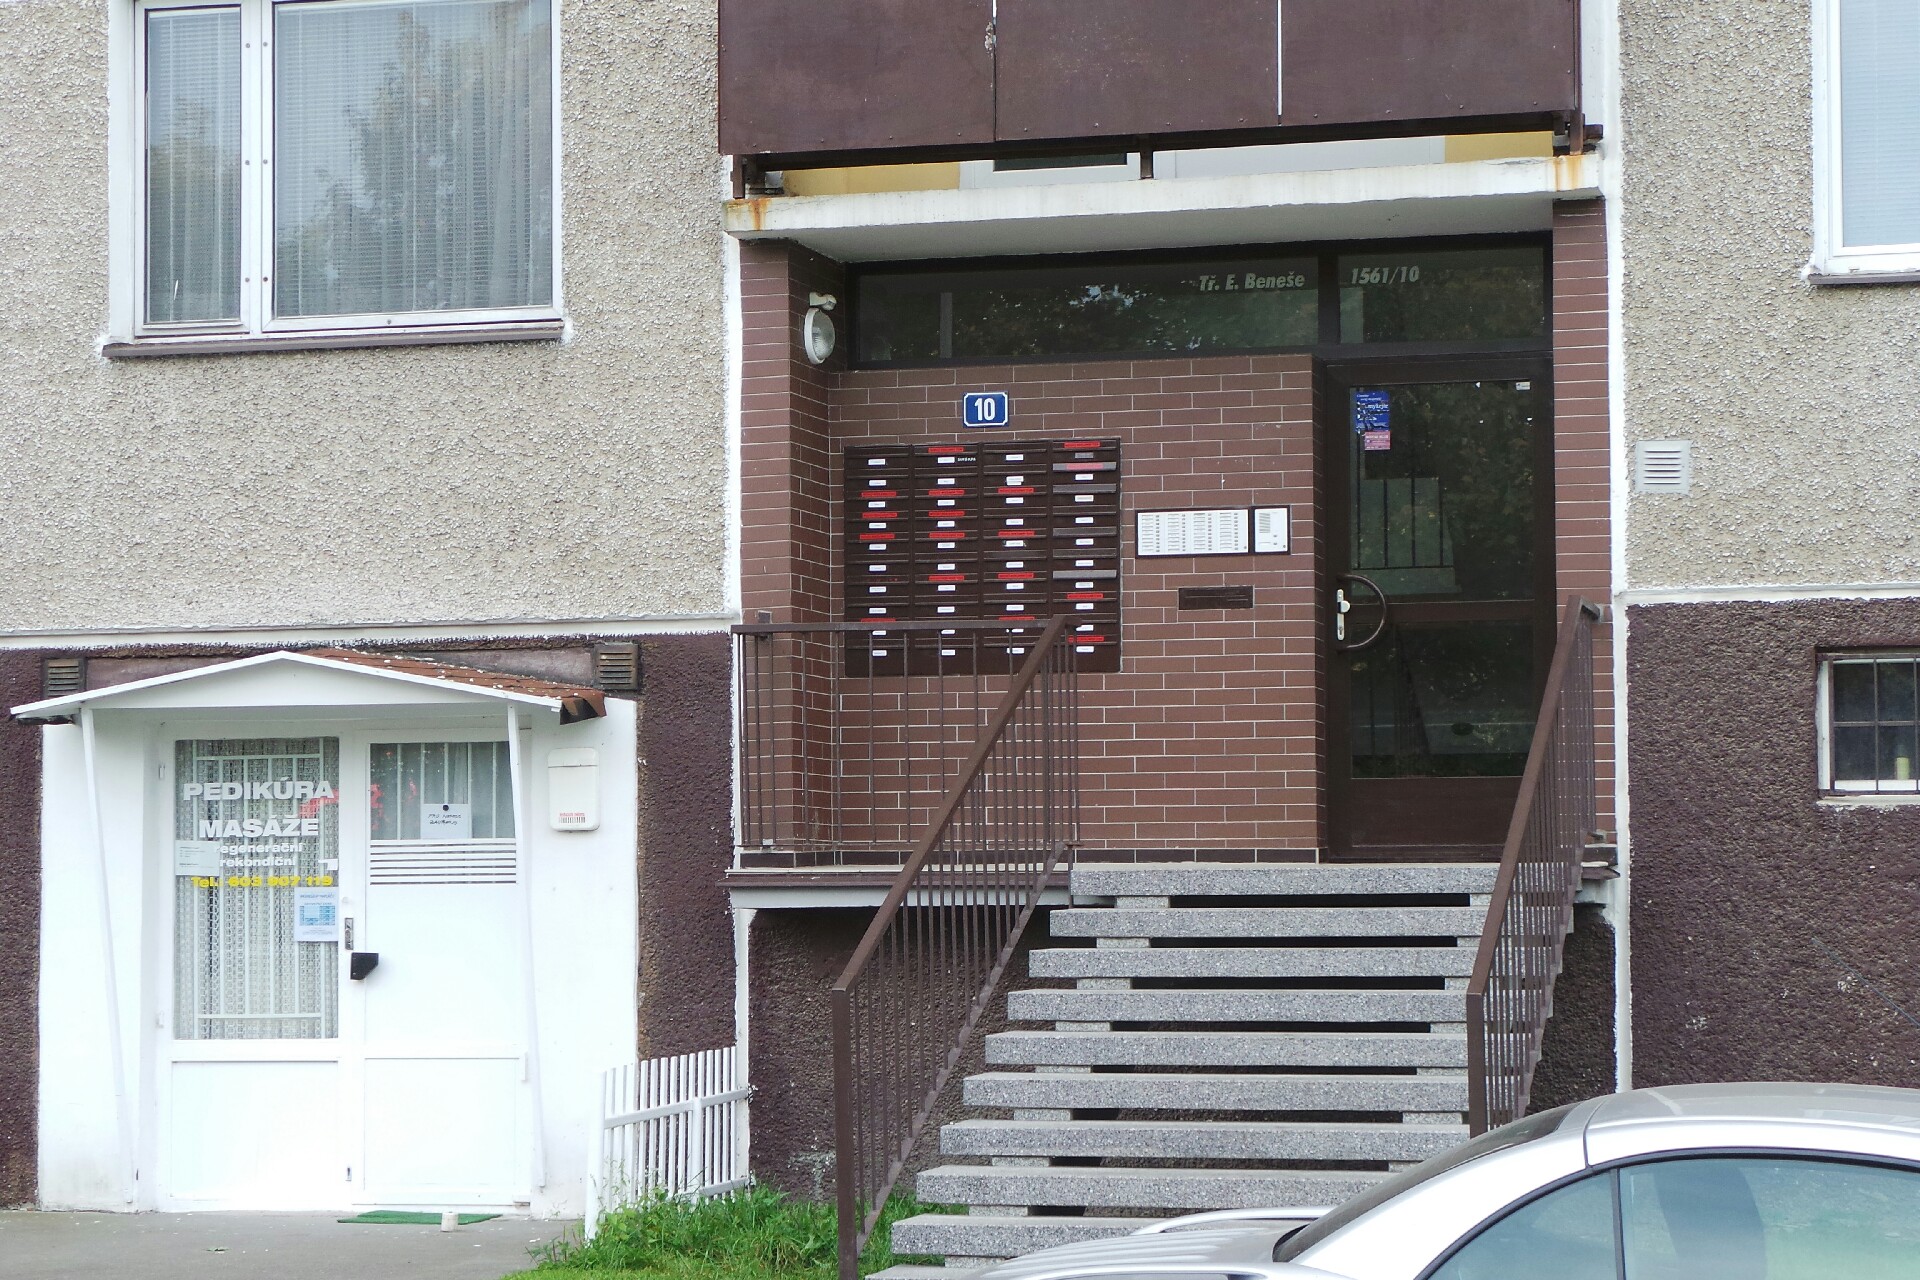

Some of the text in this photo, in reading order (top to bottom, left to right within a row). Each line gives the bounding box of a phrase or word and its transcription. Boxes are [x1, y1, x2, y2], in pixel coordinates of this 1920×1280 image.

[1199, 271, 1305, 291] Tř. E. Beneše
[1351, 265, 1420, 285] 1561/10
[974, 397, 996, 421] 10
[183, 776, 335, 801] PEDIKÚRA
[199, 814, 319, 838] MASÁŽE
[220, 856, 296, 867] rekondiční
[306, 875, 334, 887] 119
